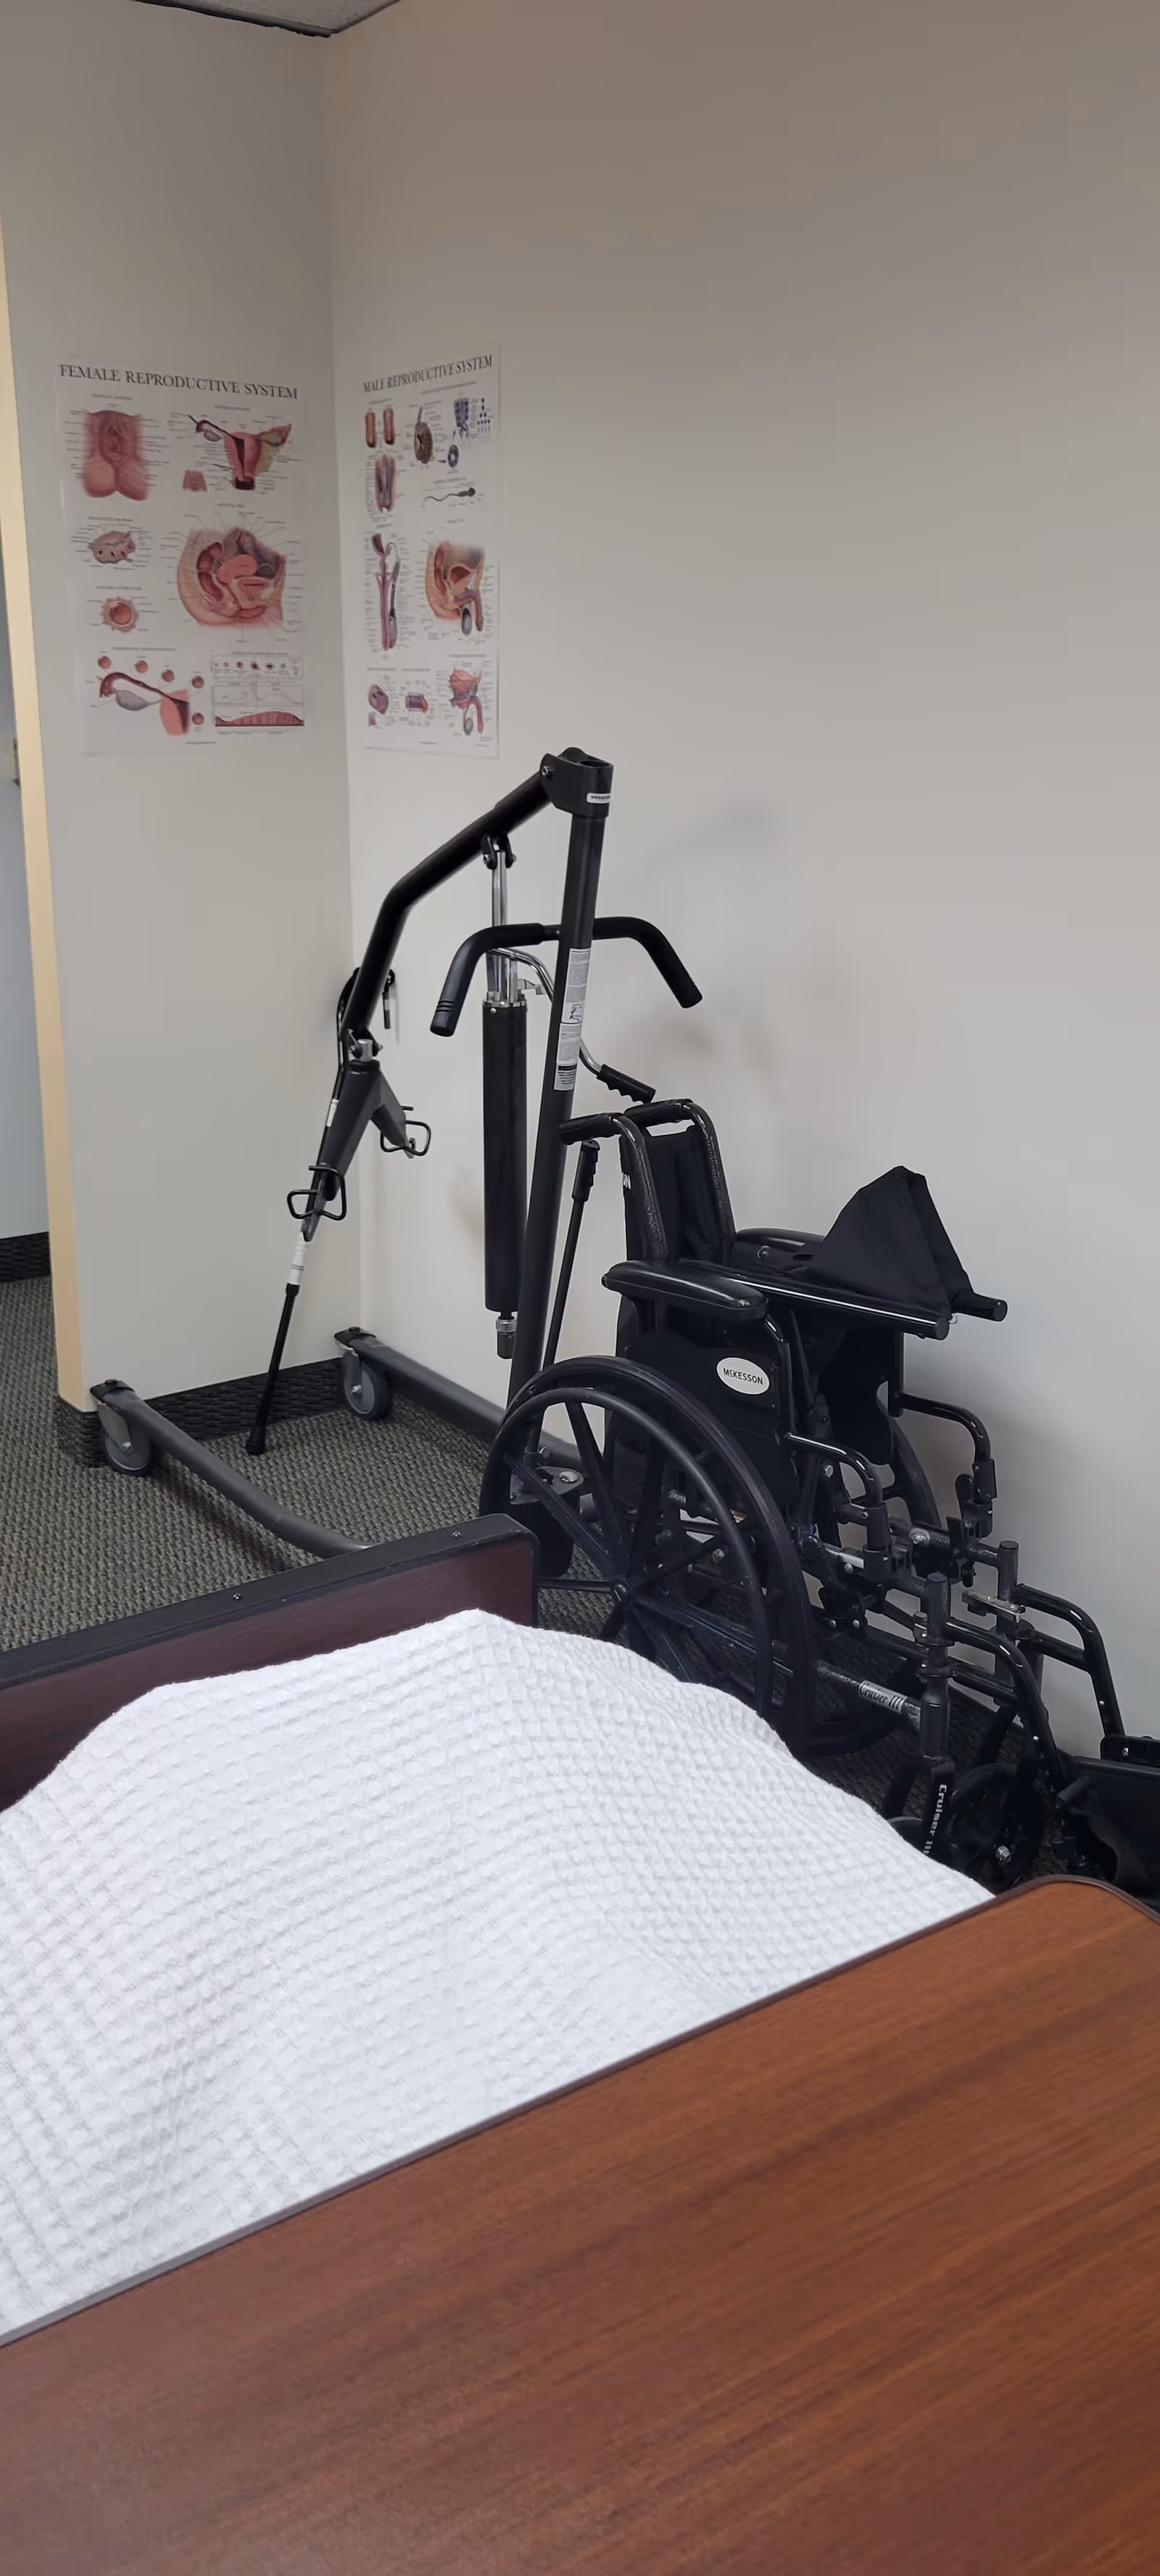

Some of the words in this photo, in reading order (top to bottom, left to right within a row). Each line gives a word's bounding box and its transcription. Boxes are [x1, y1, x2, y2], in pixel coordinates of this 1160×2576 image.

[59, 364, 121, 381] FEMALE
[125, 371, 240, 394] REPRODUCTIVE
[244, 383, 298, 399] SYSTEM
[363, 379, 386, 394] MALE
[386, 363, 455, 389] REPRODUCTIVE
[456, 355, 493, 373] SYSTEM
[859, 1683, 888, 1704] Cruiser
[929, 1784, 948, 1836] Cruiser
